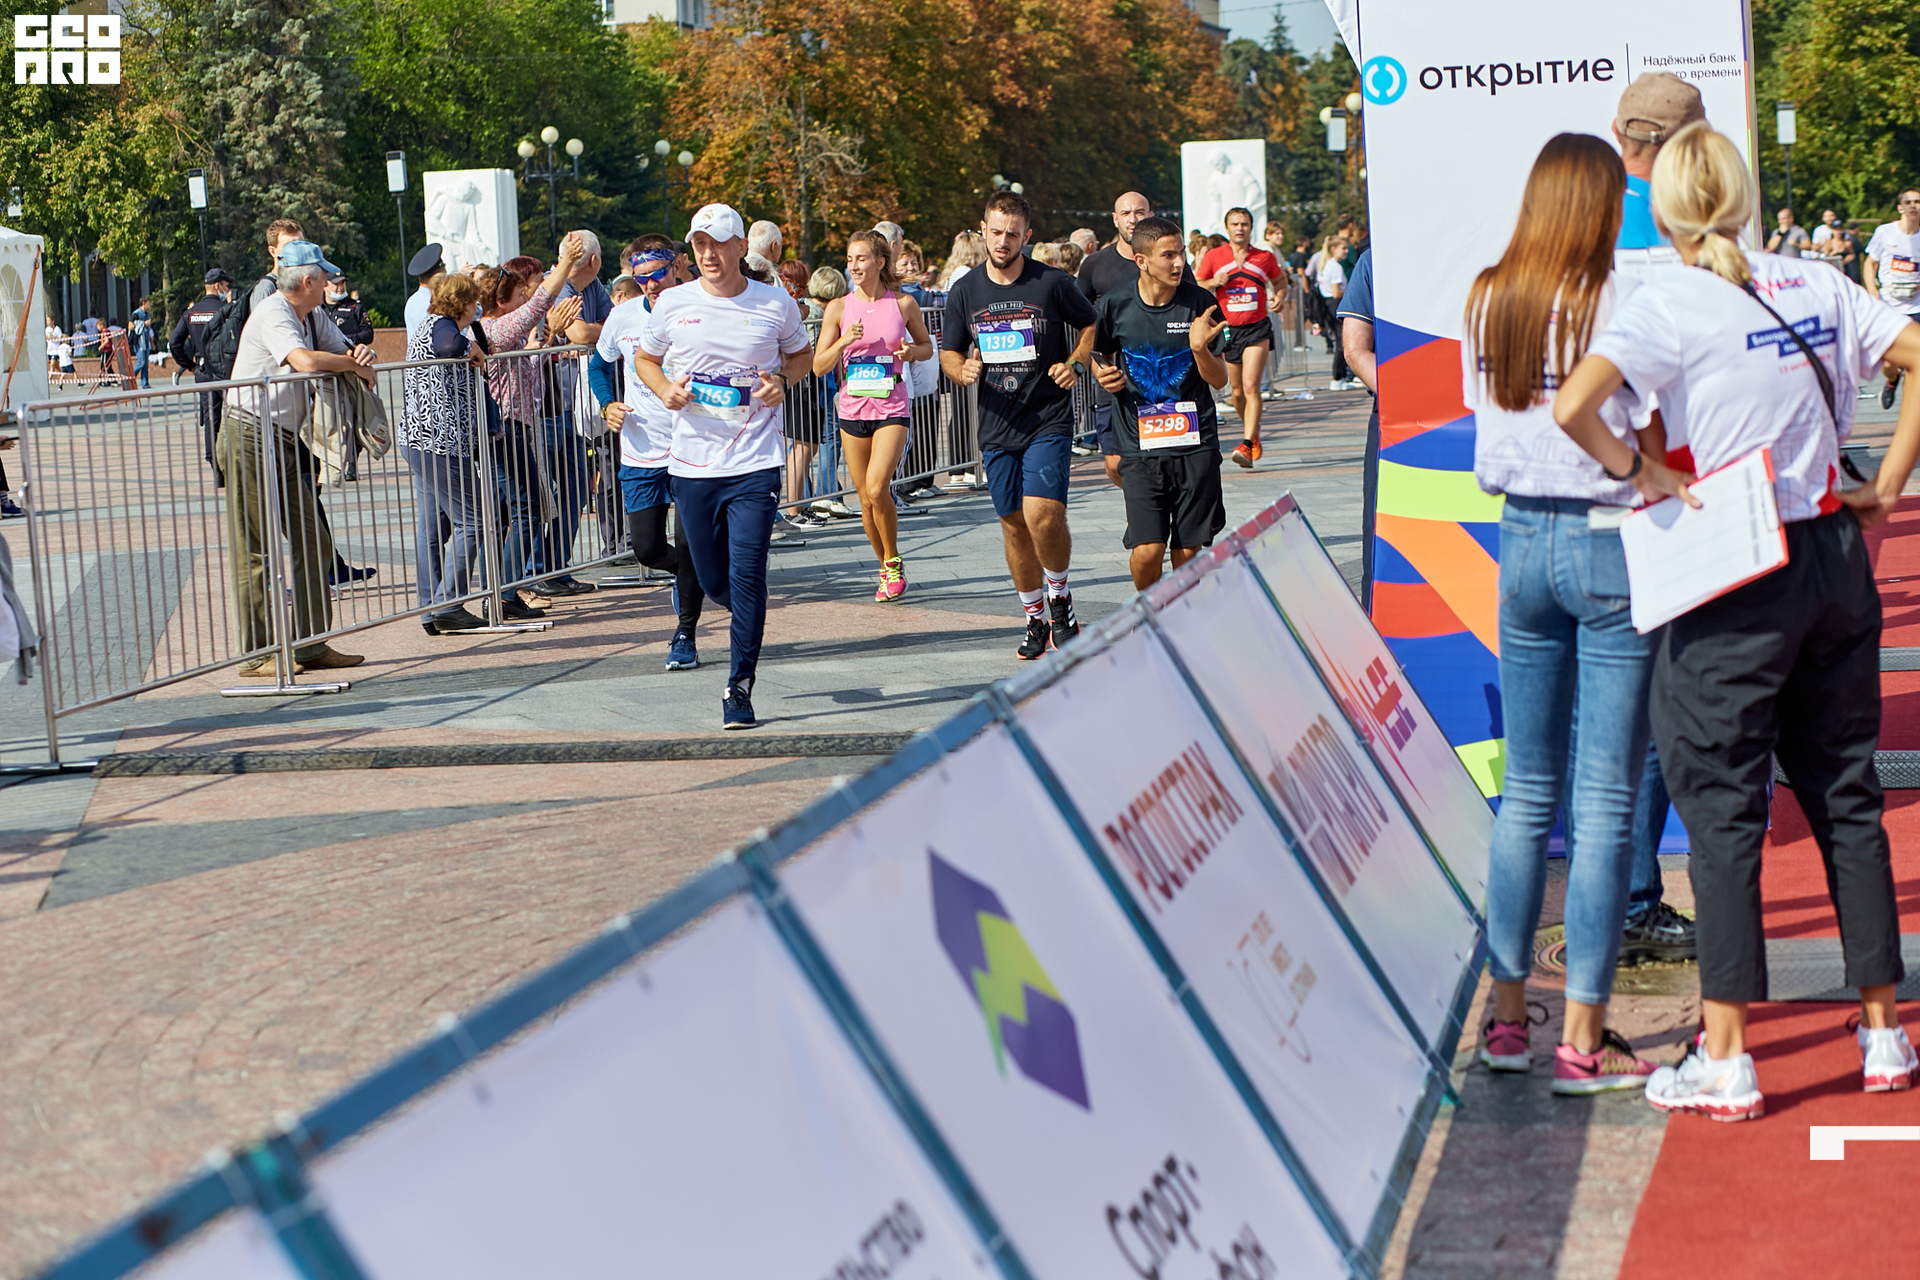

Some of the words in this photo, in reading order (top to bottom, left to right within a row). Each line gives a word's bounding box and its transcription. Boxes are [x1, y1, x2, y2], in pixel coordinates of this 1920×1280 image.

[1643, 53, 1706, 67] Надёжный
[1708, 52, 1737, 65] банк
[1419, 57, 1615, 95] открытие
[1690, 67, 1742, 80] времени
[1229, 293, 1252, 303] 2049
[985, 333, 1017, 350] 1319
[853, 366, 879, 379] 1160
[698, 387, 734, 405] 1165
[1143, 416, 1185, 434] 5298
